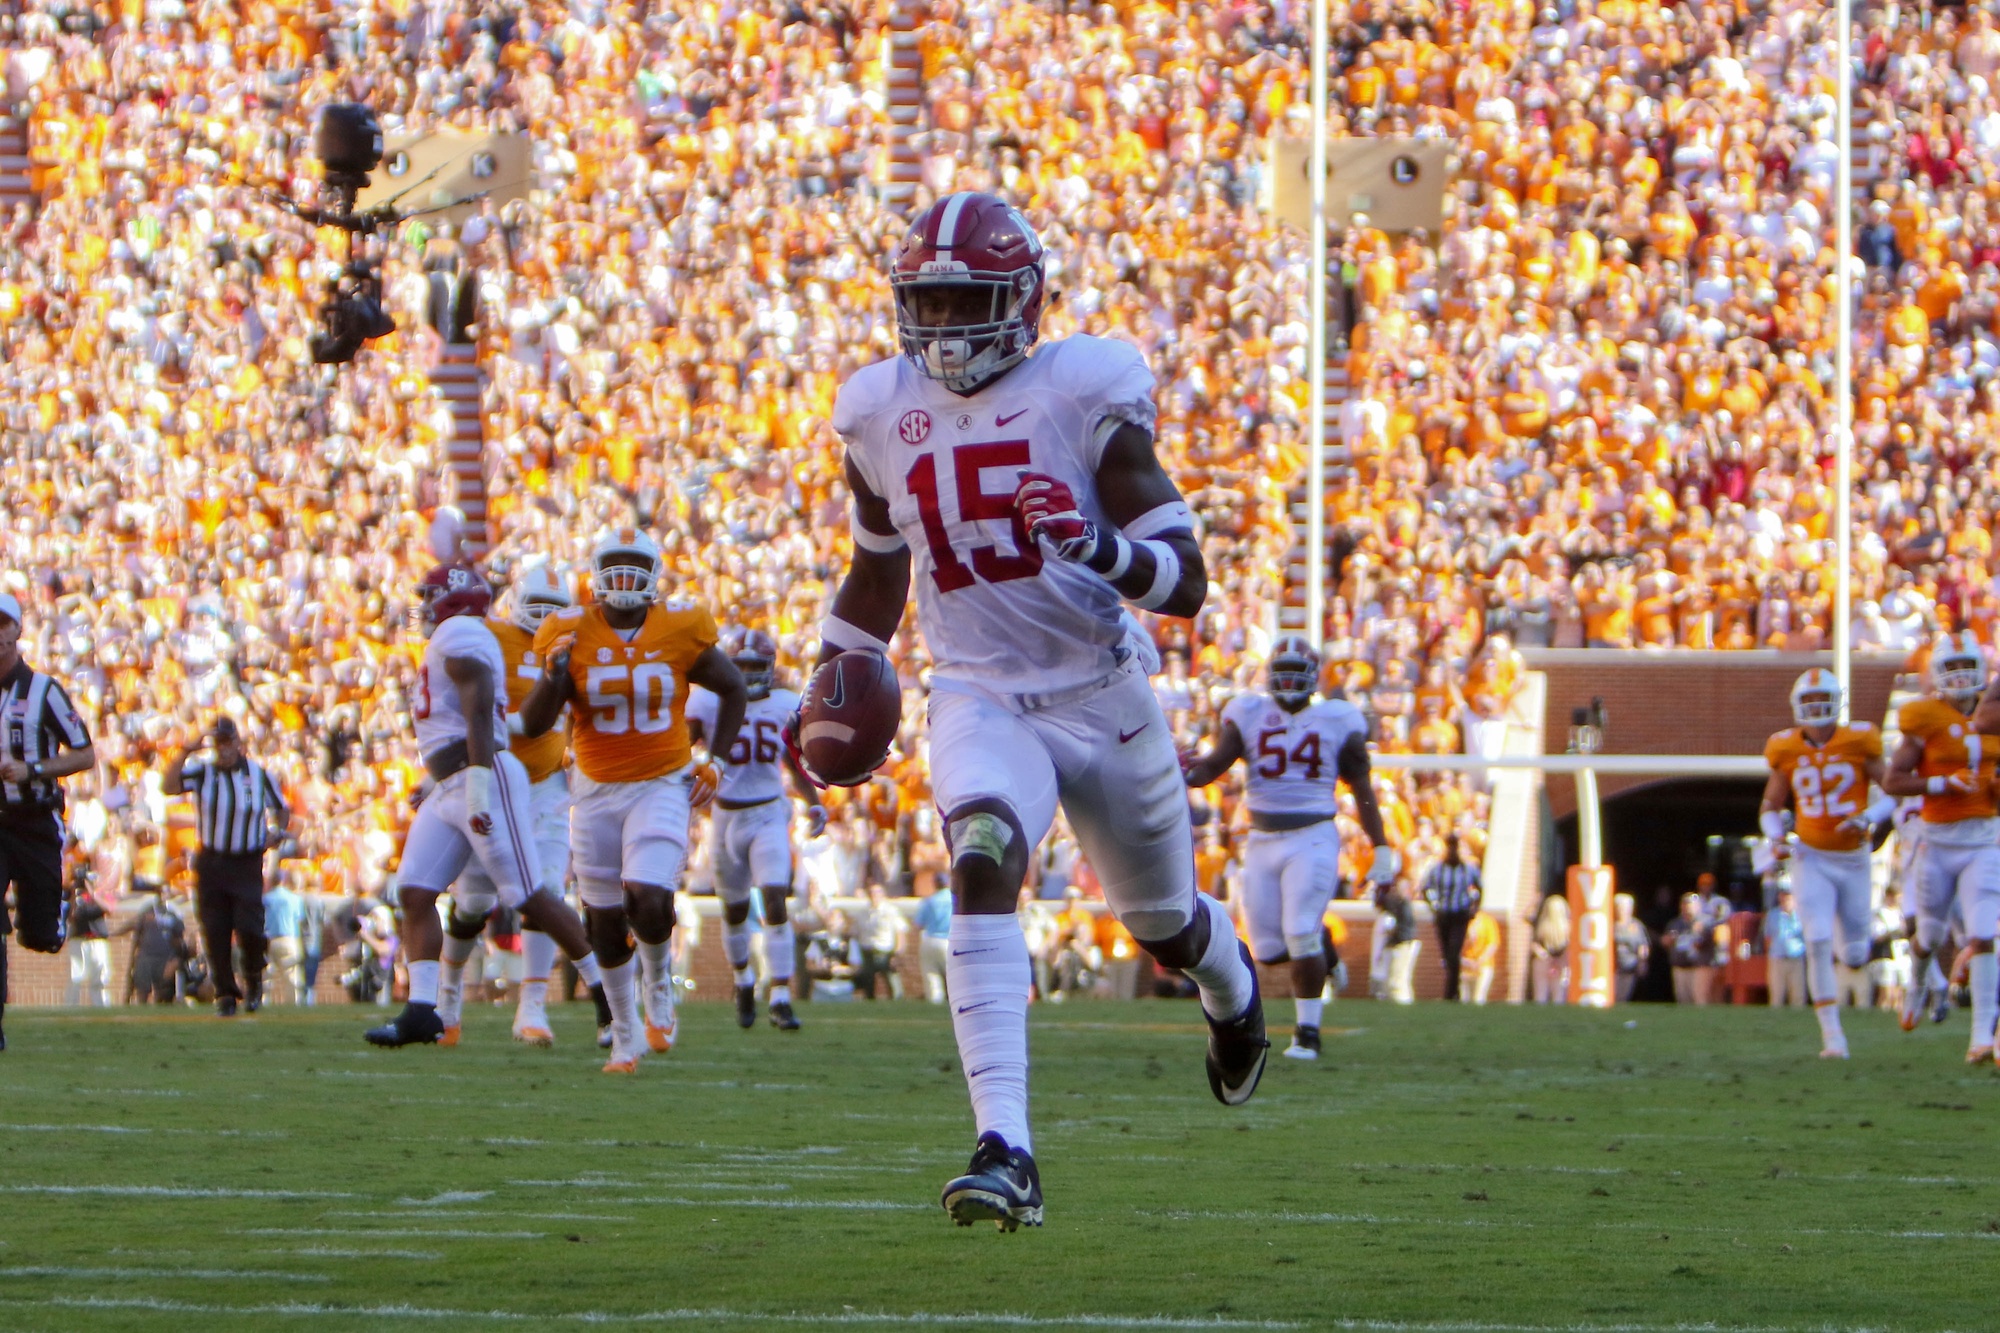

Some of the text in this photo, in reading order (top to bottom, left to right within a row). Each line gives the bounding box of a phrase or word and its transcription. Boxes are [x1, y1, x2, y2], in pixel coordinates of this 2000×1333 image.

[388, 152, 408, 177] J
[472, 153, 494, 177] K
[1395, 157, 1413, 182] L
[928, 264, 955, 272] BAMA
[900, 410, 931, 444] SEC
[905, 439, 1044, 594] 15
[447, 568, 468, 587] 93
[586, 662, 675, 734] 50
[728, 718, 778, 766] 56
[1258, 726, 1323, 780] 54
